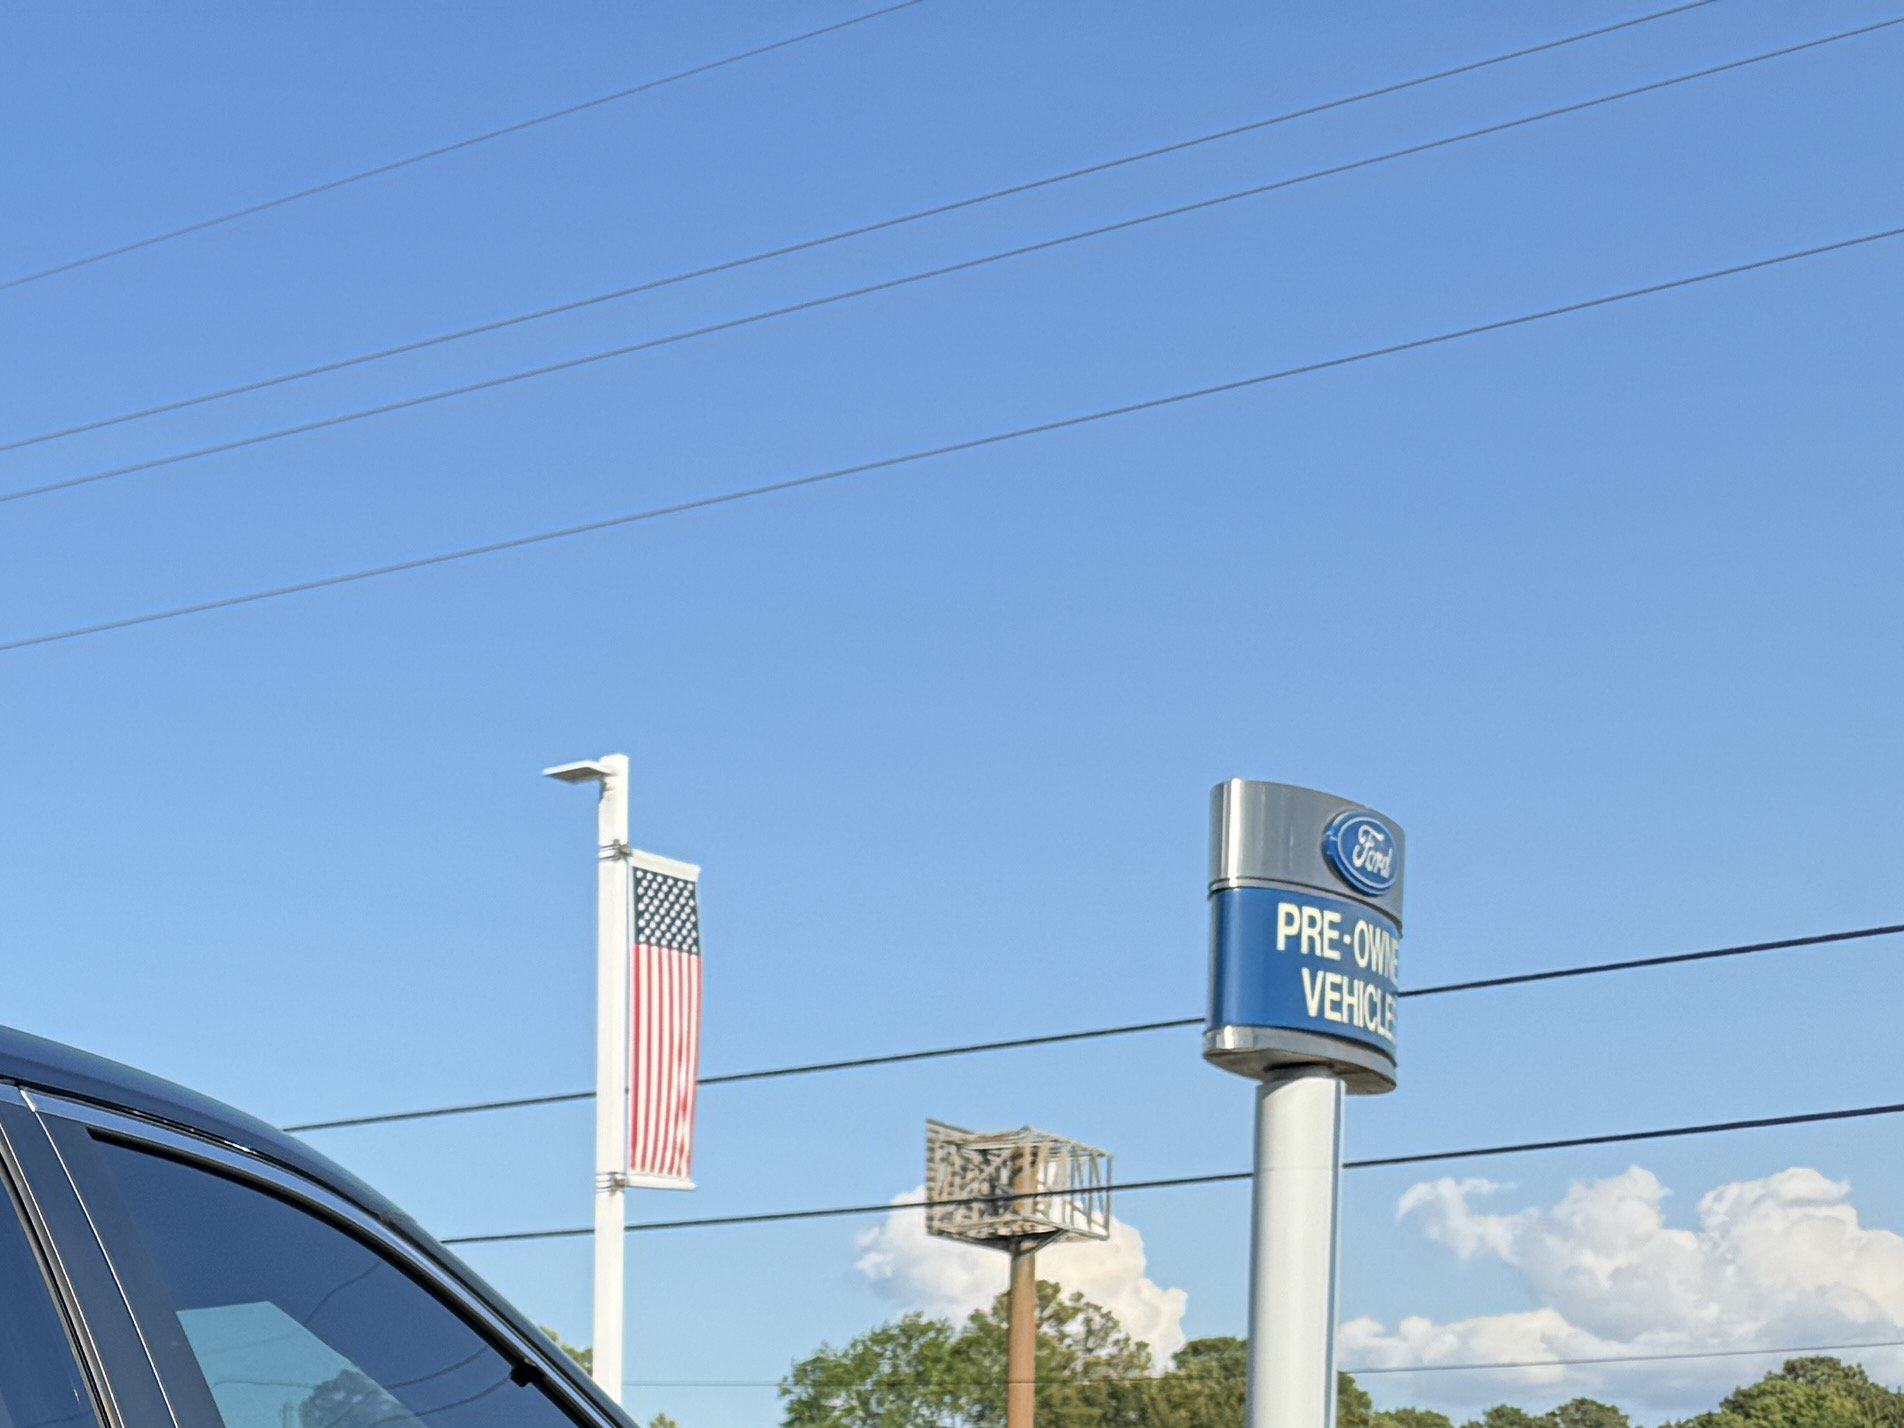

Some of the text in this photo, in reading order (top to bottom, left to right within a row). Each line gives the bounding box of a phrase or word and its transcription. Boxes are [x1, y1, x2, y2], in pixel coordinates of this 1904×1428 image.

[1352, 824, 1393, 878] Ford
[1277, 902, 1398, 985] PRE-OWNE
[1301, 967, 1396, 1043] VEHICLE
